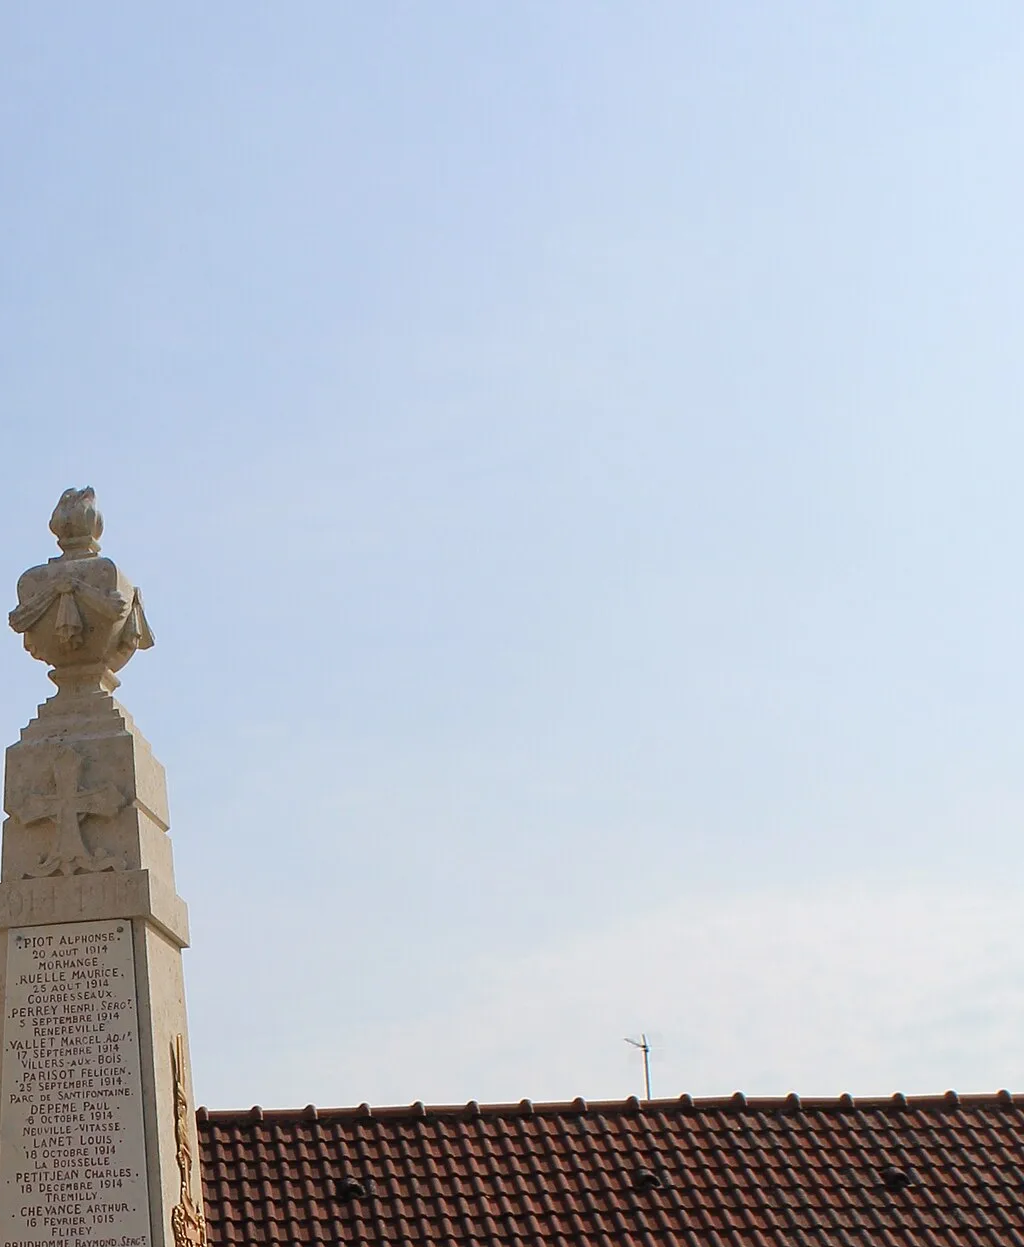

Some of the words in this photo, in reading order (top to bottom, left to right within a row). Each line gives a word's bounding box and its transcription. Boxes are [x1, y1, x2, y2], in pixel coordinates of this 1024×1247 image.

[24, 936, 53, 948] PIOT
[33, 950, 45, 959] 20
[51, 948, 79, 957] AOUT
[86, 945, 107, 954] 1914
[20, 972, 66, 984] RUELLE
[34, 985, 46, 993] 25
[51, 983, 81, 992] AOUT
[87, 979, 109, 988] 1914
[12, 1006, 58, 1018] PERREY
[20, 1020, 25, 1028] 5
[32, 1014, 92, 1026] SEPTEMBRE
[98, 1012, 119, 1021] 1914
[34, 1023, 105, 1036] RENEREVILLE
[10, 1038, 56, 1050] VALLET
[18, 1051, 27, 1059] 17
[34, 1047, 92, 1058] SEPTEMBRE
[99, 1044, 119, 1052] 1914
[24, 1069, 75, 1082] PARISOT
[20, 1084, 31, 1092] 25
[39, 1079, 94, 1091] SEPTEMBRE
[10, 1094, 34, 1103] PARC
[31, 1103, 77, 1114] DEPEME
[41, 1114, 85, 1124] OCTOBRE
[91, 1112, 113, 1120] 1914
[34, 1137, 73, 1148] LANET
[26, 1151, 37, 1159] 18
[43, 1148, 88, 1158] OCTOBRE
[95, 1146, 115, 1155] 1914
[35, 1161, 47, 1169] LA
[16, 1170, 78, 1183] PETITJEAN
[21, 1185, 32, 1193] 18
[39, 1182, 92, 1192] DECEMBRE
[100, 1180, 123, 1188] 1914
[21, 1205, 81, 1217] CHEVANCE
[27, 1218, 36, 1227] 16
[44, 1216, 86, 1226] FEVRIER
